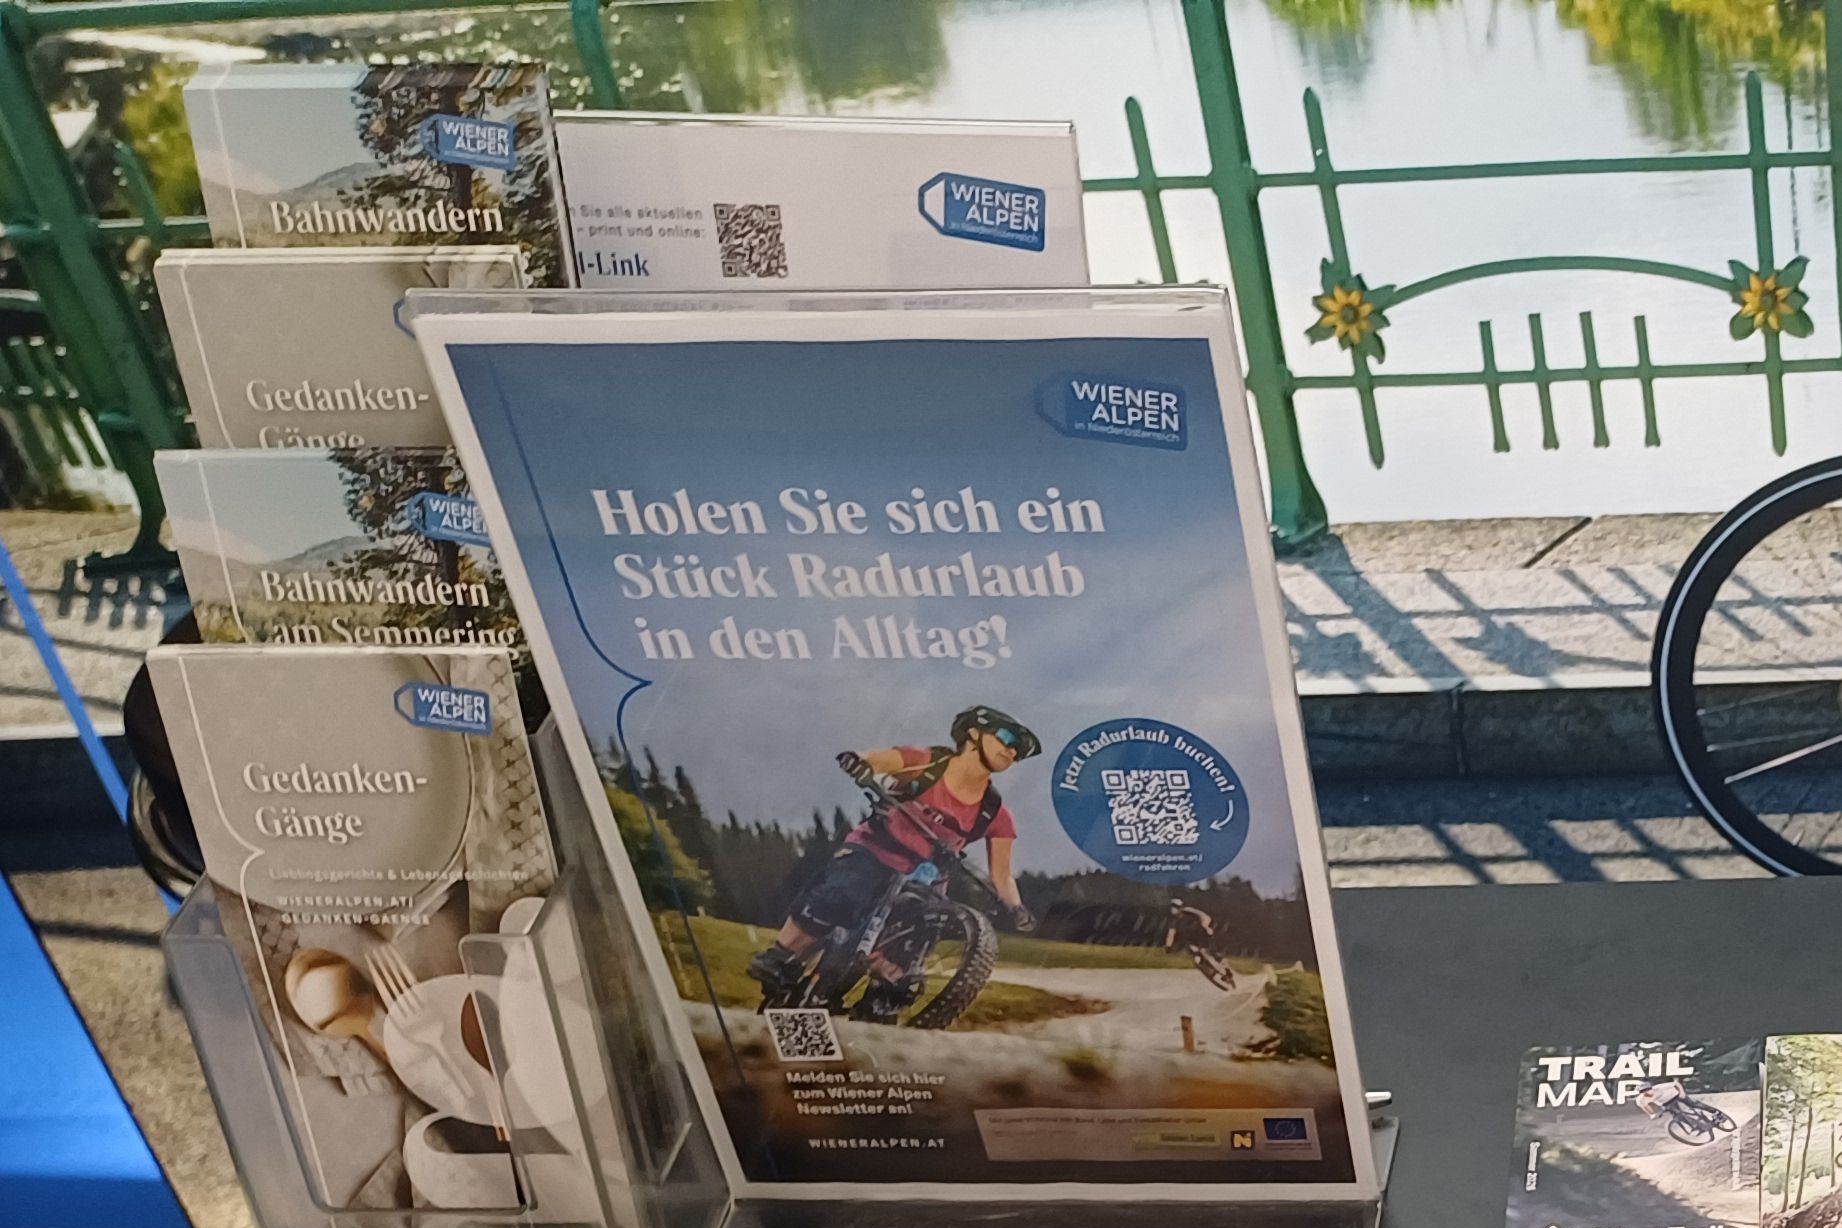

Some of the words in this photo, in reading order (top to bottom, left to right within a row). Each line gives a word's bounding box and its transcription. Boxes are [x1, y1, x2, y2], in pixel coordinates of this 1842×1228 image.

[443, 119, 509, 142] WIENER
[455, 136, 510, 158] ALPEN
[951, 182, 1039, 213] WIENER
[271, 200, 503, 236] Bahnwandern
[965, 204, 1039, 232] ALPEN
[246, 380, 429, 414] Gedanken-
[1071, 380, 1178, 412] WIENER
[1092, 403, 1179, 432] ALPEN
[429, 499, 480, 518] WIENE
[592, 489, 766, 537] Holen
[779, 489, 866, 536] Sie
[886, 489, 1000, 534] sich
[1019, 487, 1105, 533] ein
[442, 514, 487, 534] ALPE
[261, 570, 490, 608] Bahnwandern
[614, 553, 777, 600] Stück
[790, 551, 1085, 599] Radurlaub
[274, 624, 322, 645] am
[634, 616, 694, 661] in
[709, 617, 811, 660] den
[831, 615, 1013, 669] Alltag!
[417, 689, 485, 710] WIENER
[429, 703, 486, 724] ALPEN
[1060, 755, 1085, 792] Jetzt
[1078, 726, 1170, 759] Radurlaub
[1174, 736, 1236, 793] buchen!
[243, 762, 427, 795] Gedanken-
[255, 807, 364, 844] Gänge
[786, 1071, 846, 1084] Melden
[850, 1071, 874, 1084] Sie
[878, 1071, 908, 1084] sich
[912, 1072, 945, 1085] hier
[1538, 1052, 1695, 1082] TRAIL
[793, 1089, 825, 1100] zum
[827, 1087, 883, 1100] Wiener
[887, 1087, 932, 1102] Alpen
[1537, 1079, 1643, 1108] MAP
[797, 1103, 884, 1116] Newsletter
[888, 1102, 912, 1115] an!
[808, 1137, 945, 1149] WIENERALPEN.AT
